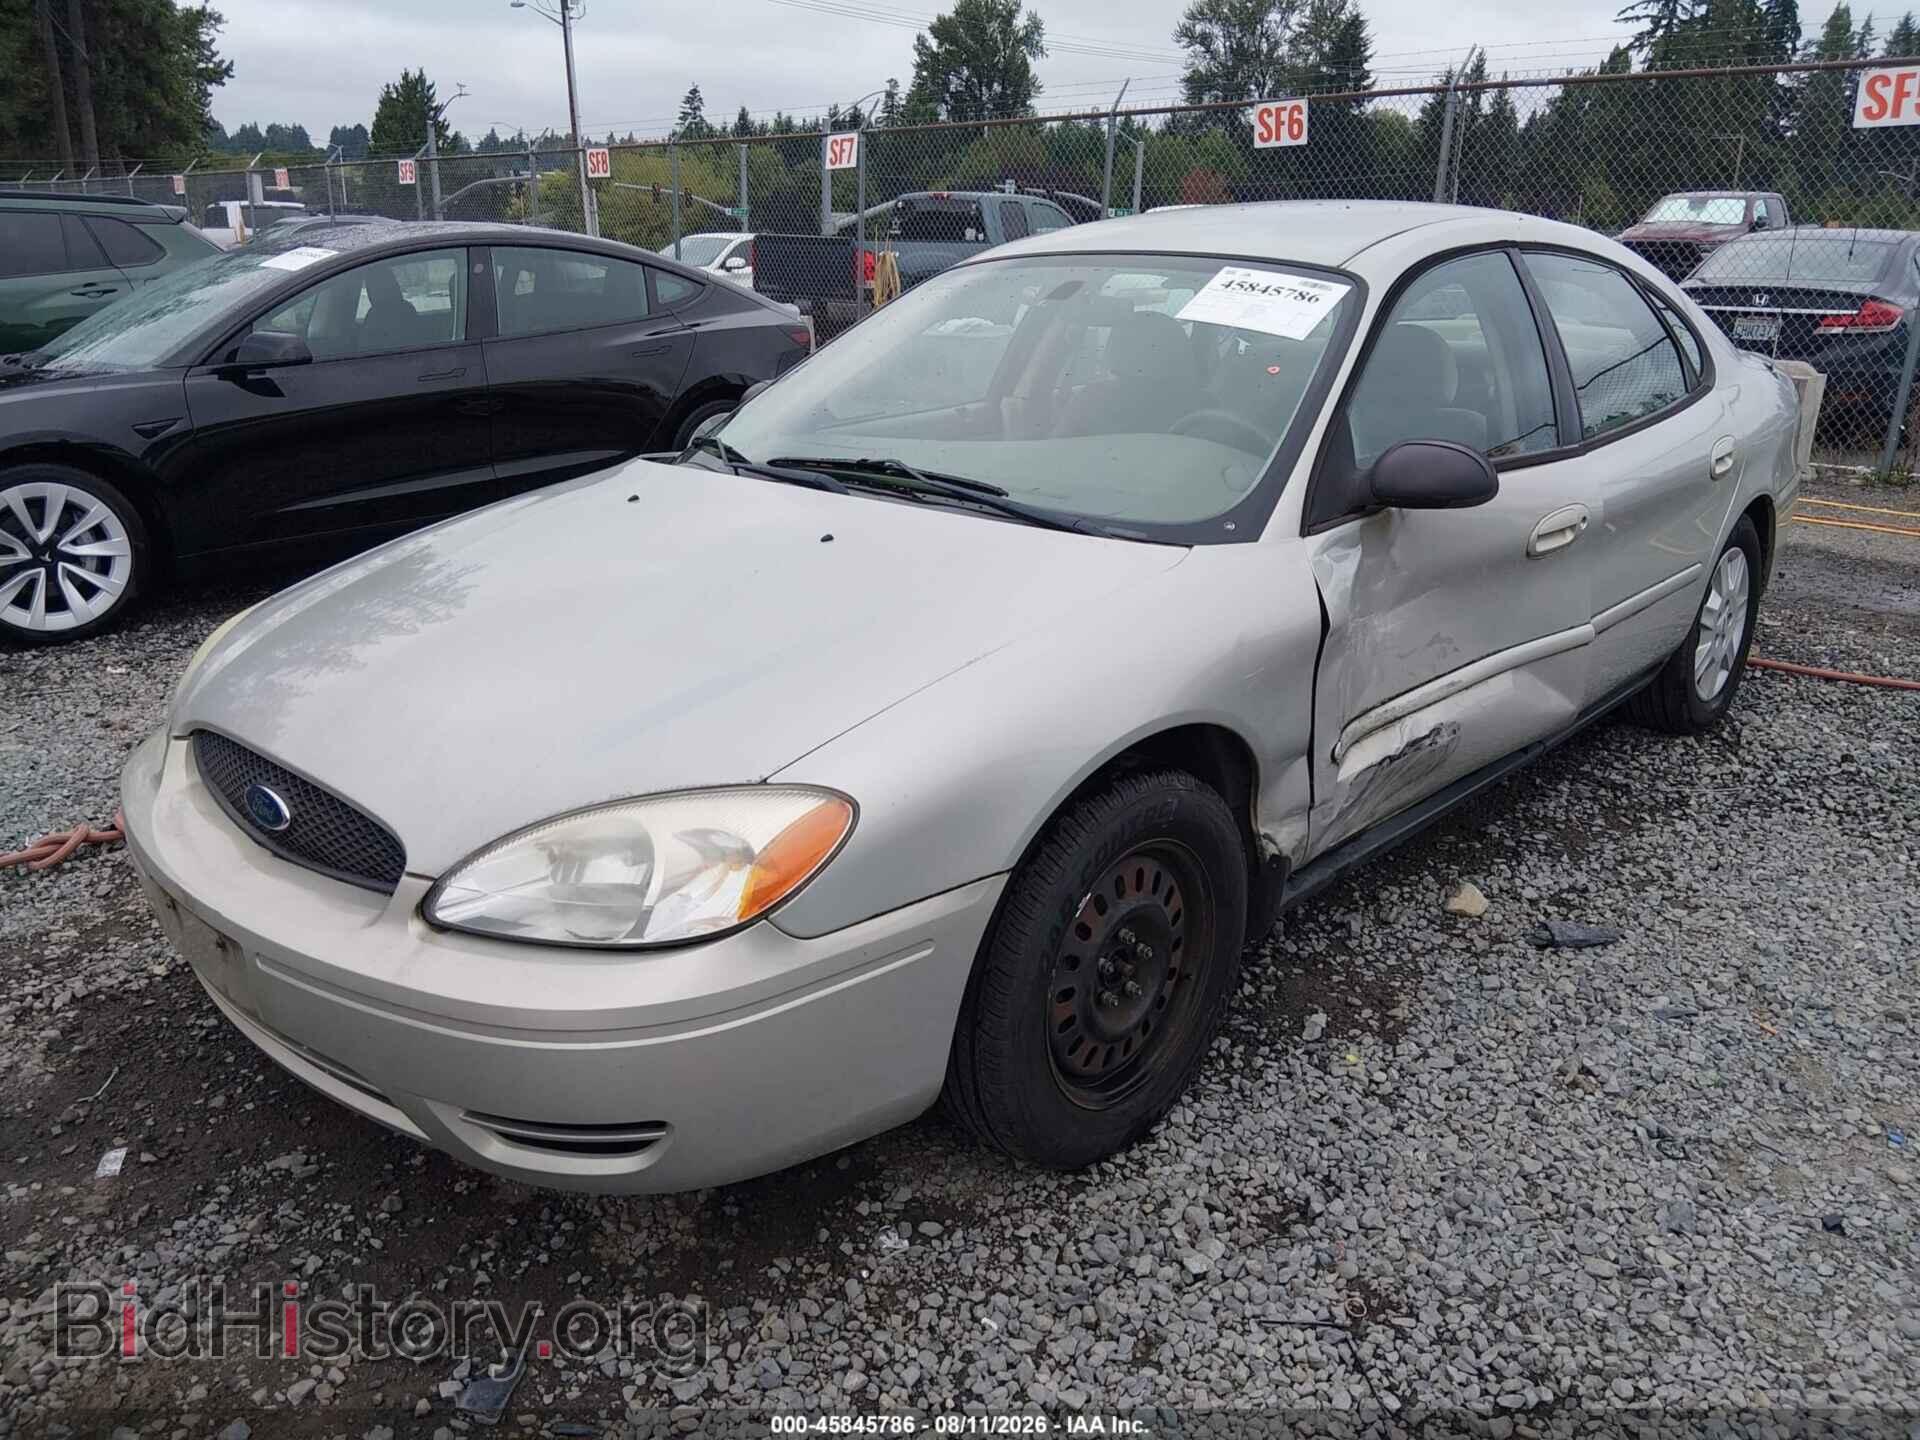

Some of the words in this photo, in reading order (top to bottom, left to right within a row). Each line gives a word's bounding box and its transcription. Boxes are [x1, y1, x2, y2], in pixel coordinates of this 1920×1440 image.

[1258, 104, 1304, 143] SF6
[588, 151, 609, 174] SF8
[830, 138, 854, 165] SF7
[400, 162, 415, 182] SF9
[1220, 279, 1319, 304] 45845786
